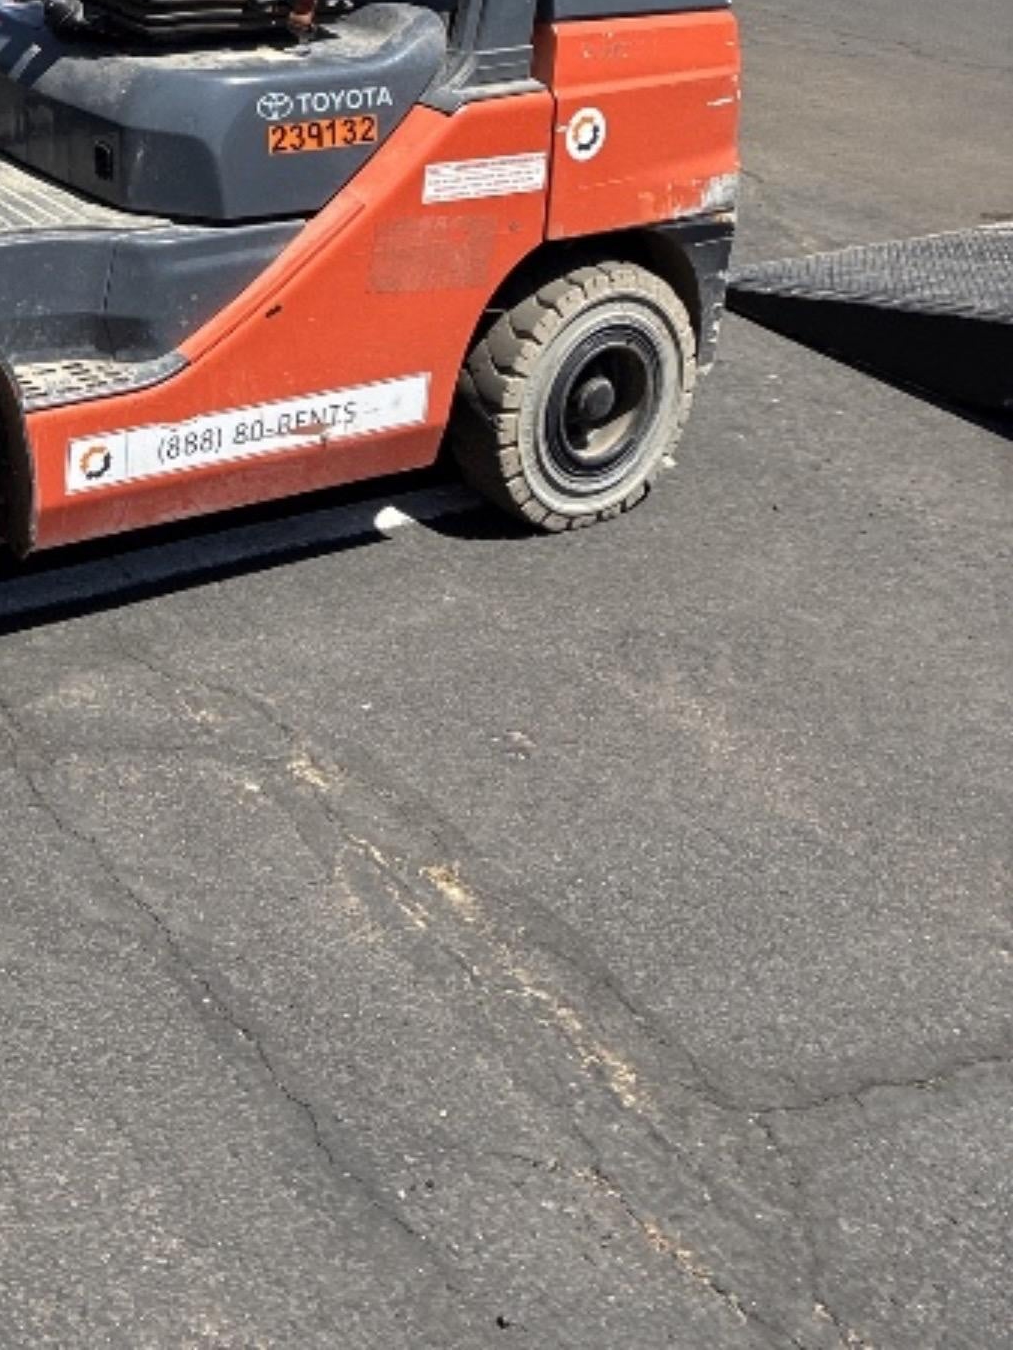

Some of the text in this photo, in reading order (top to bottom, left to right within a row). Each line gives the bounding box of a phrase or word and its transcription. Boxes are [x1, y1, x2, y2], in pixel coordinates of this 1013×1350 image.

[296, 86, 393, 115] TOYOTA
[271, 116, 375, 151] 239132
[156, 401, 357, 464] (888) 80-RENTS
